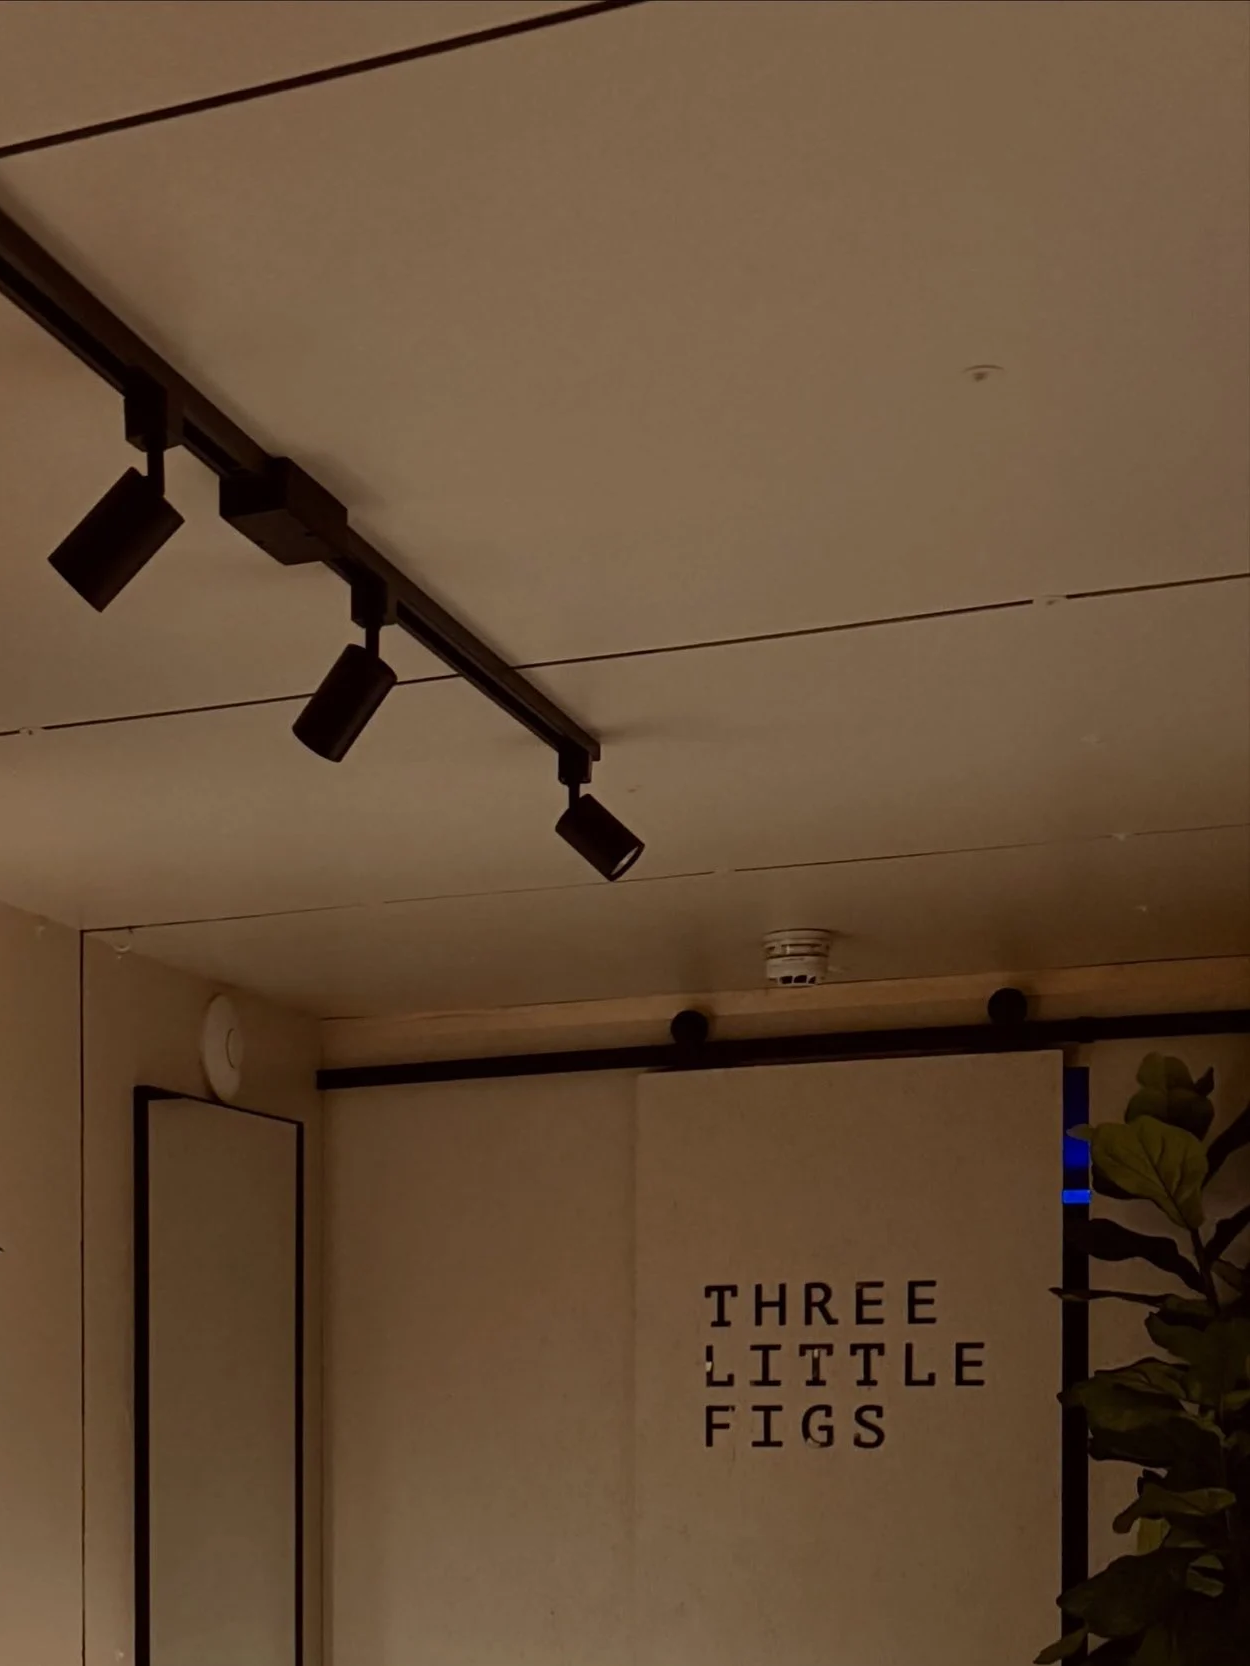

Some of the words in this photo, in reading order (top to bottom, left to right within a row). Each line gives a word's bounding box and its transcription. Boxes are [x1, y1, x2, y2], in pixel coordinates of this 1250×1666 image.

[703, 1279, 938, 1328] THREE
[704, 1341, 986, 1388] LITTLE
[704, 1403, 887, 1449] FIGS
